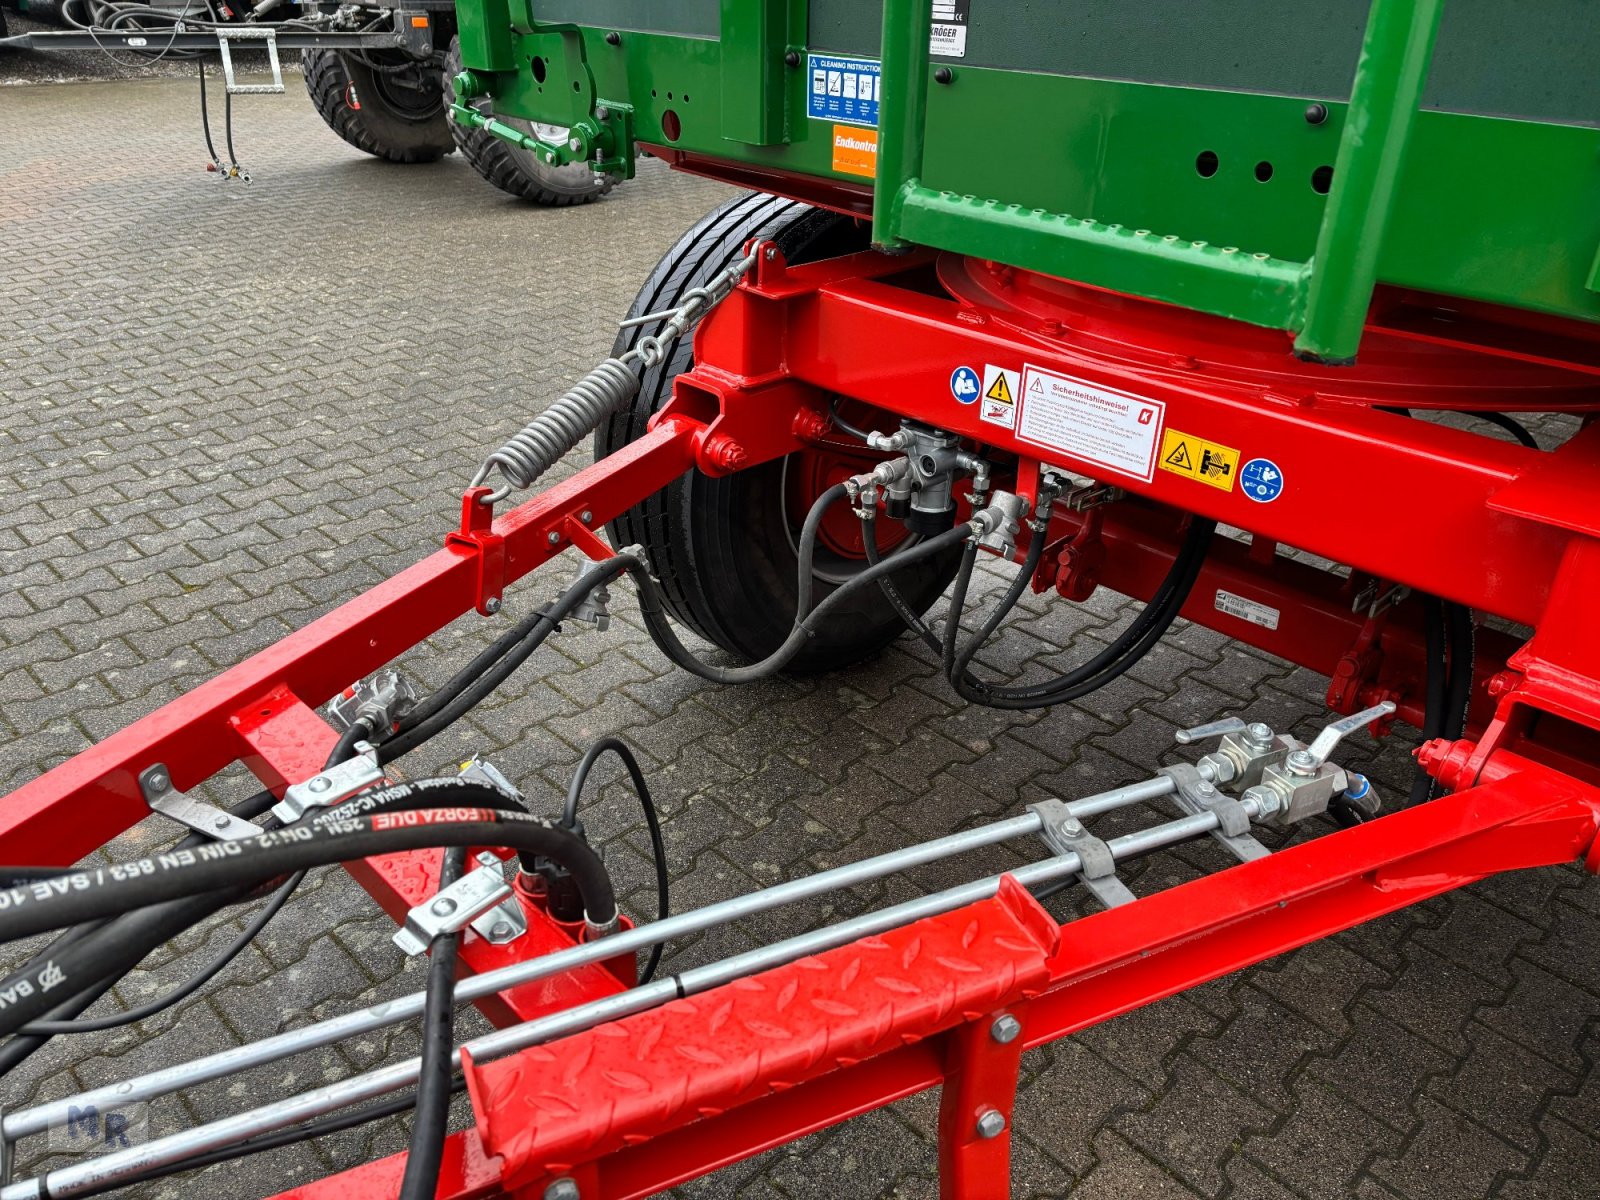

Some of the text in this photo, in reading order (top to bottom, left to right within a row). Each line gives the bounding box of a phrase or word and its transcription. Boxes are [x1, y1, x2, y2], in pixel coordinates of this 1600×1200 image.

[820, 60, 846, 70] CLEANING
[835, 135, 878, 153] Endkontro
[1052, 383, 1130, 412] Sicherheitshinweise!
[374, 783, 412, 800] MSHA
[378, 812, 421, 827] DUE
[424, 808, 479, 823] FORZA
[158, 850, 197, 870] EN
[198, 841, 242, 861] DIN
[109, 858, 155, 881] 853
[30, 872, 90, 901] SAE
